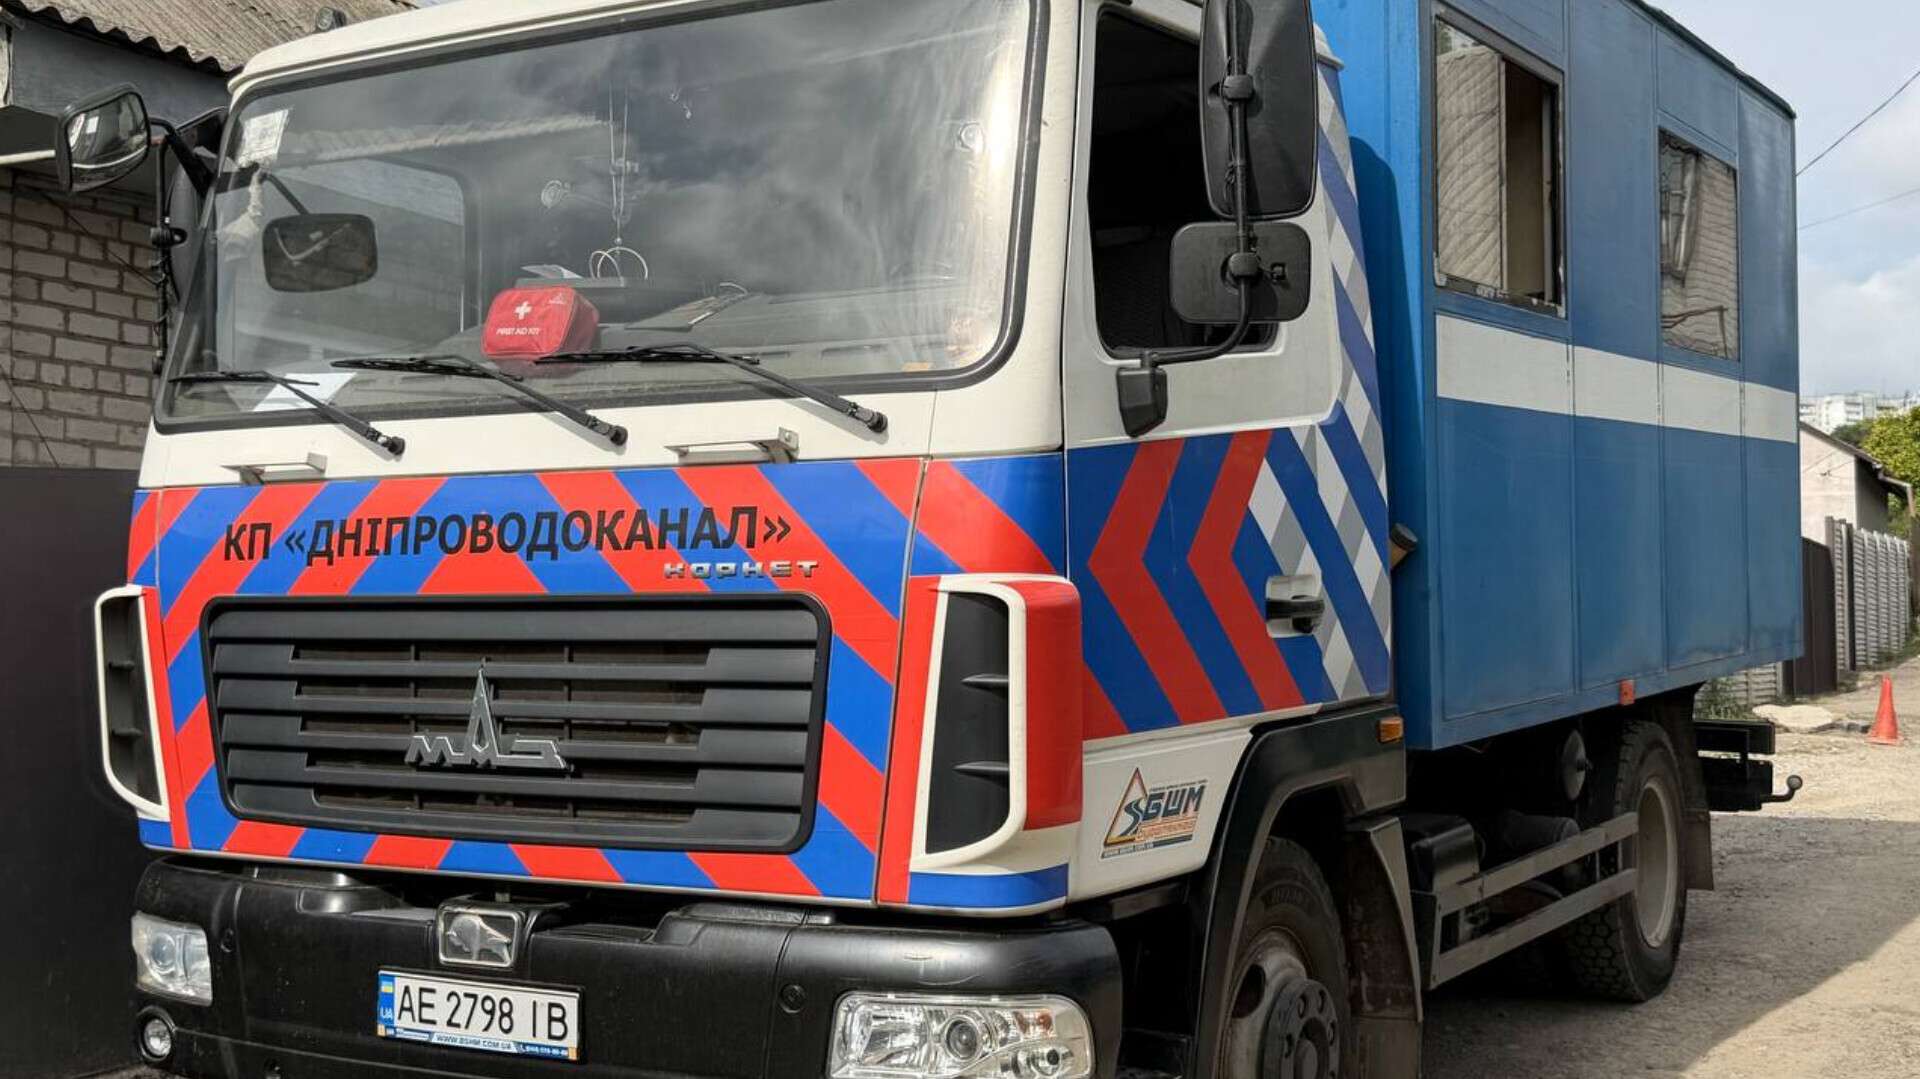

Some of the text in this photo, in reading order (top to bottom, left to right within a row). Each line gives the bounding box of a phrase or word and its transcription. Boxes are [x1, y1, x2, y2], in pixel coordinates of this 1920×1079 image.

[224, 506, 792, 567] КП «ДНІПРОВОДОКАНАЛ»
[663, 560, 819, 580] КОРНЕТ
[379, 1007, 393, 1020] UA
[398, 985, 568, 1041] AE 2798 IB
